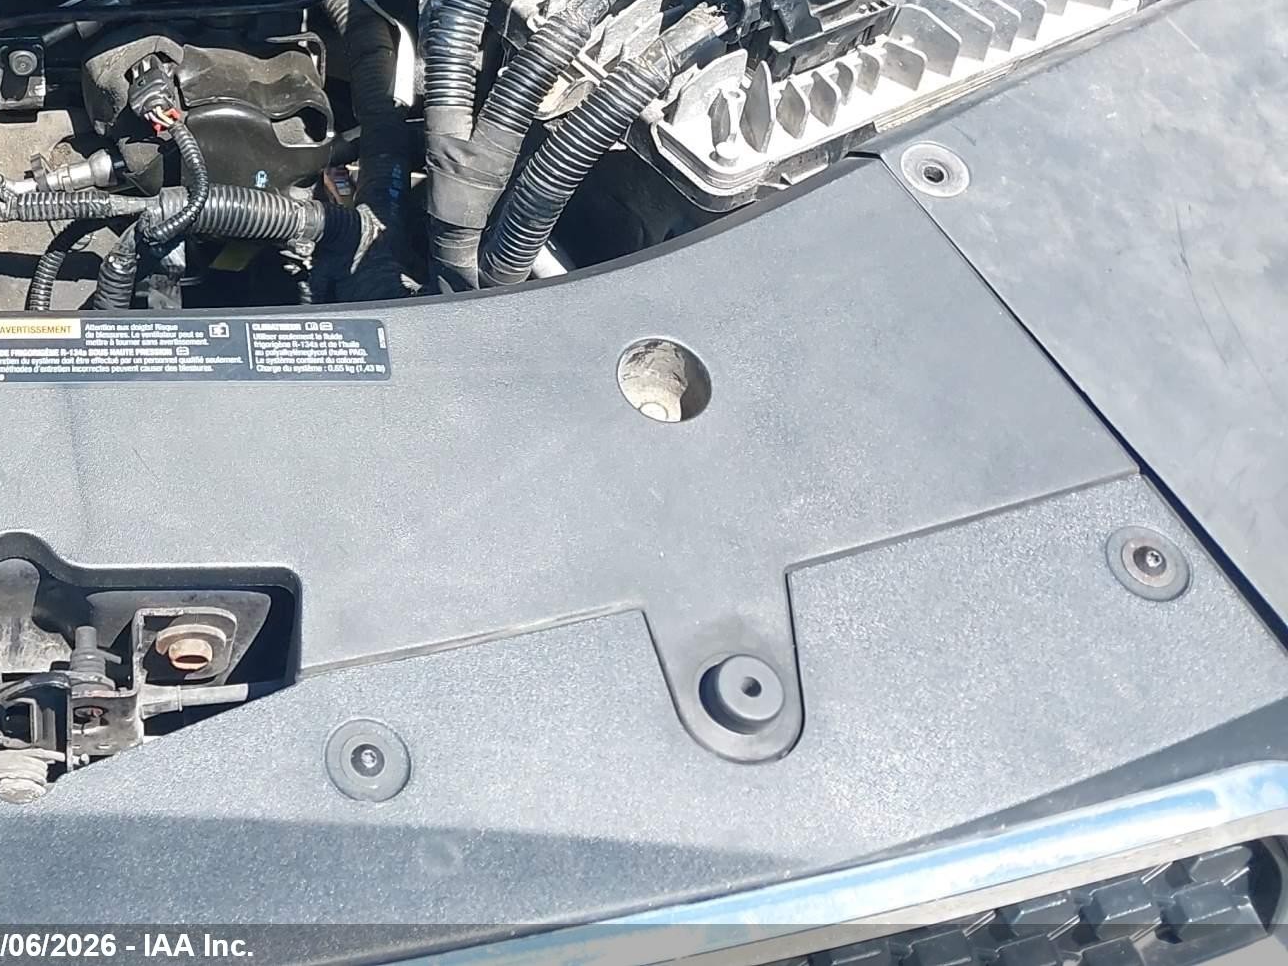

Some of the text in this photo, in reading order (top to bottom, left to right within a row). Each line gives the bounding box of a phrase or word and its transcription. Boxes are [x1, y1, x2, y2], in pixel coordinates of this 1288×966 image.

[0, 325, 72, 334] AVERTISSEMENT
[85, 323, 116, 331] Attention
[292, 340, 319, 348] R-134a
[345, 365, 355, 373] kg
